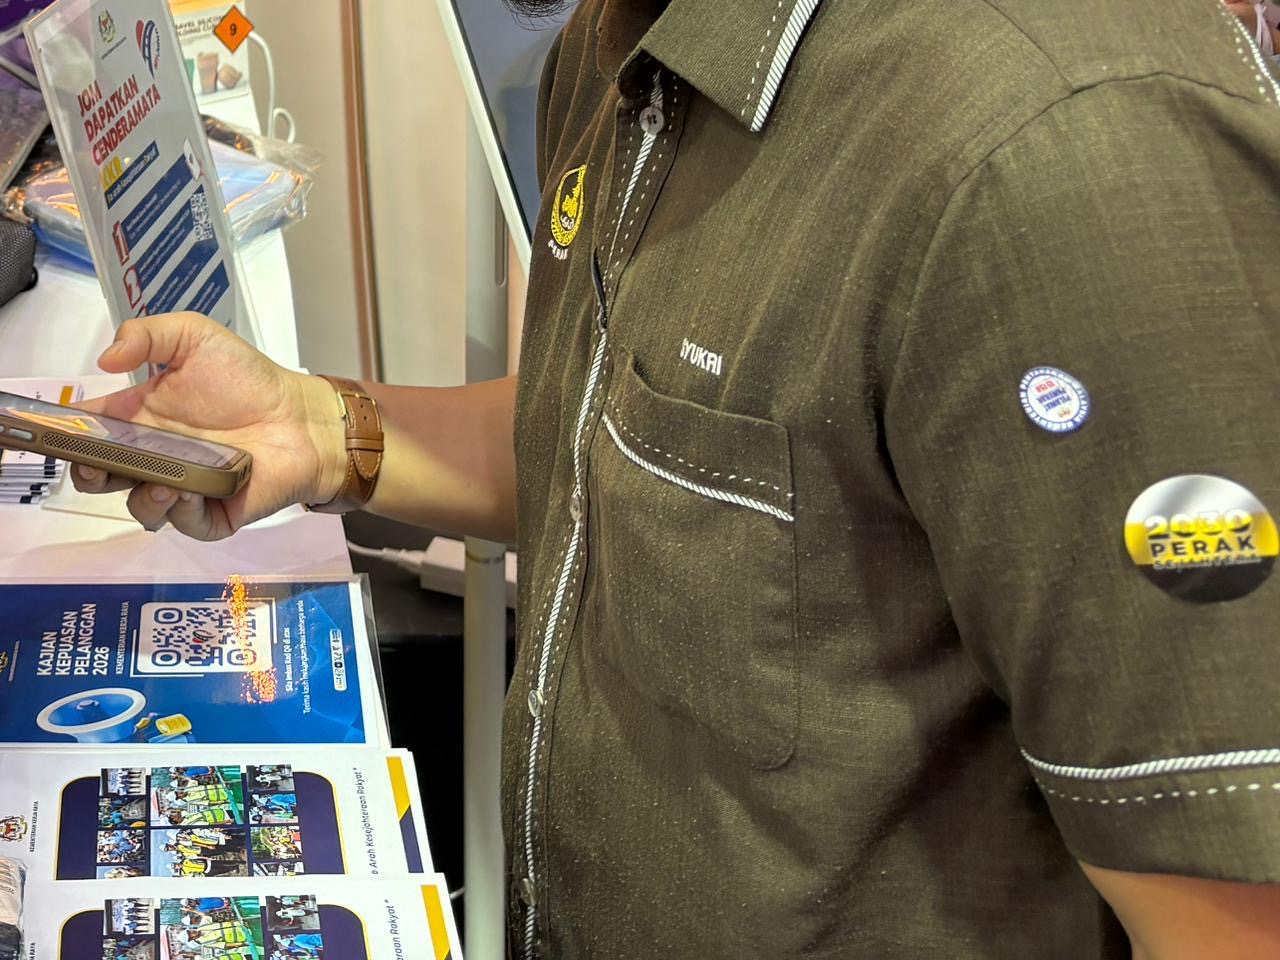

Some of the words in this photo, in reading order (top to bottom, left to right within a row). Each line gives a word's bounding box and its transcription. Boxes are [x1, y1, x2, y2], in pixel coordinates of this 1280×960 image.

[229, 23, 238, 37] 9
[78, 79, 102, 118] JOM
[83, 73, 140, 144] DAPATKAN
[92, 83, 161, 167] CENDERAMATA
[1143, 509, 1253, 540] 2030
[1150, 535, 1255, 557] PERAK
[36, 631, 58, 676] KAJIAN
[55, 611, 78, 676] KEPUASAN
[74, 603, 97, 676] PELANGGAN
[115, 634, 126, 675] KEMENTERIAN
[92, 646, 110, 676] 2026
[355, 771, 368, 795] Rakyat
[360, 794, 375, 847] Kesejahteraan
[367, 847, 378, 868] Arah
[388, 905, 399, 935] Rakyat
